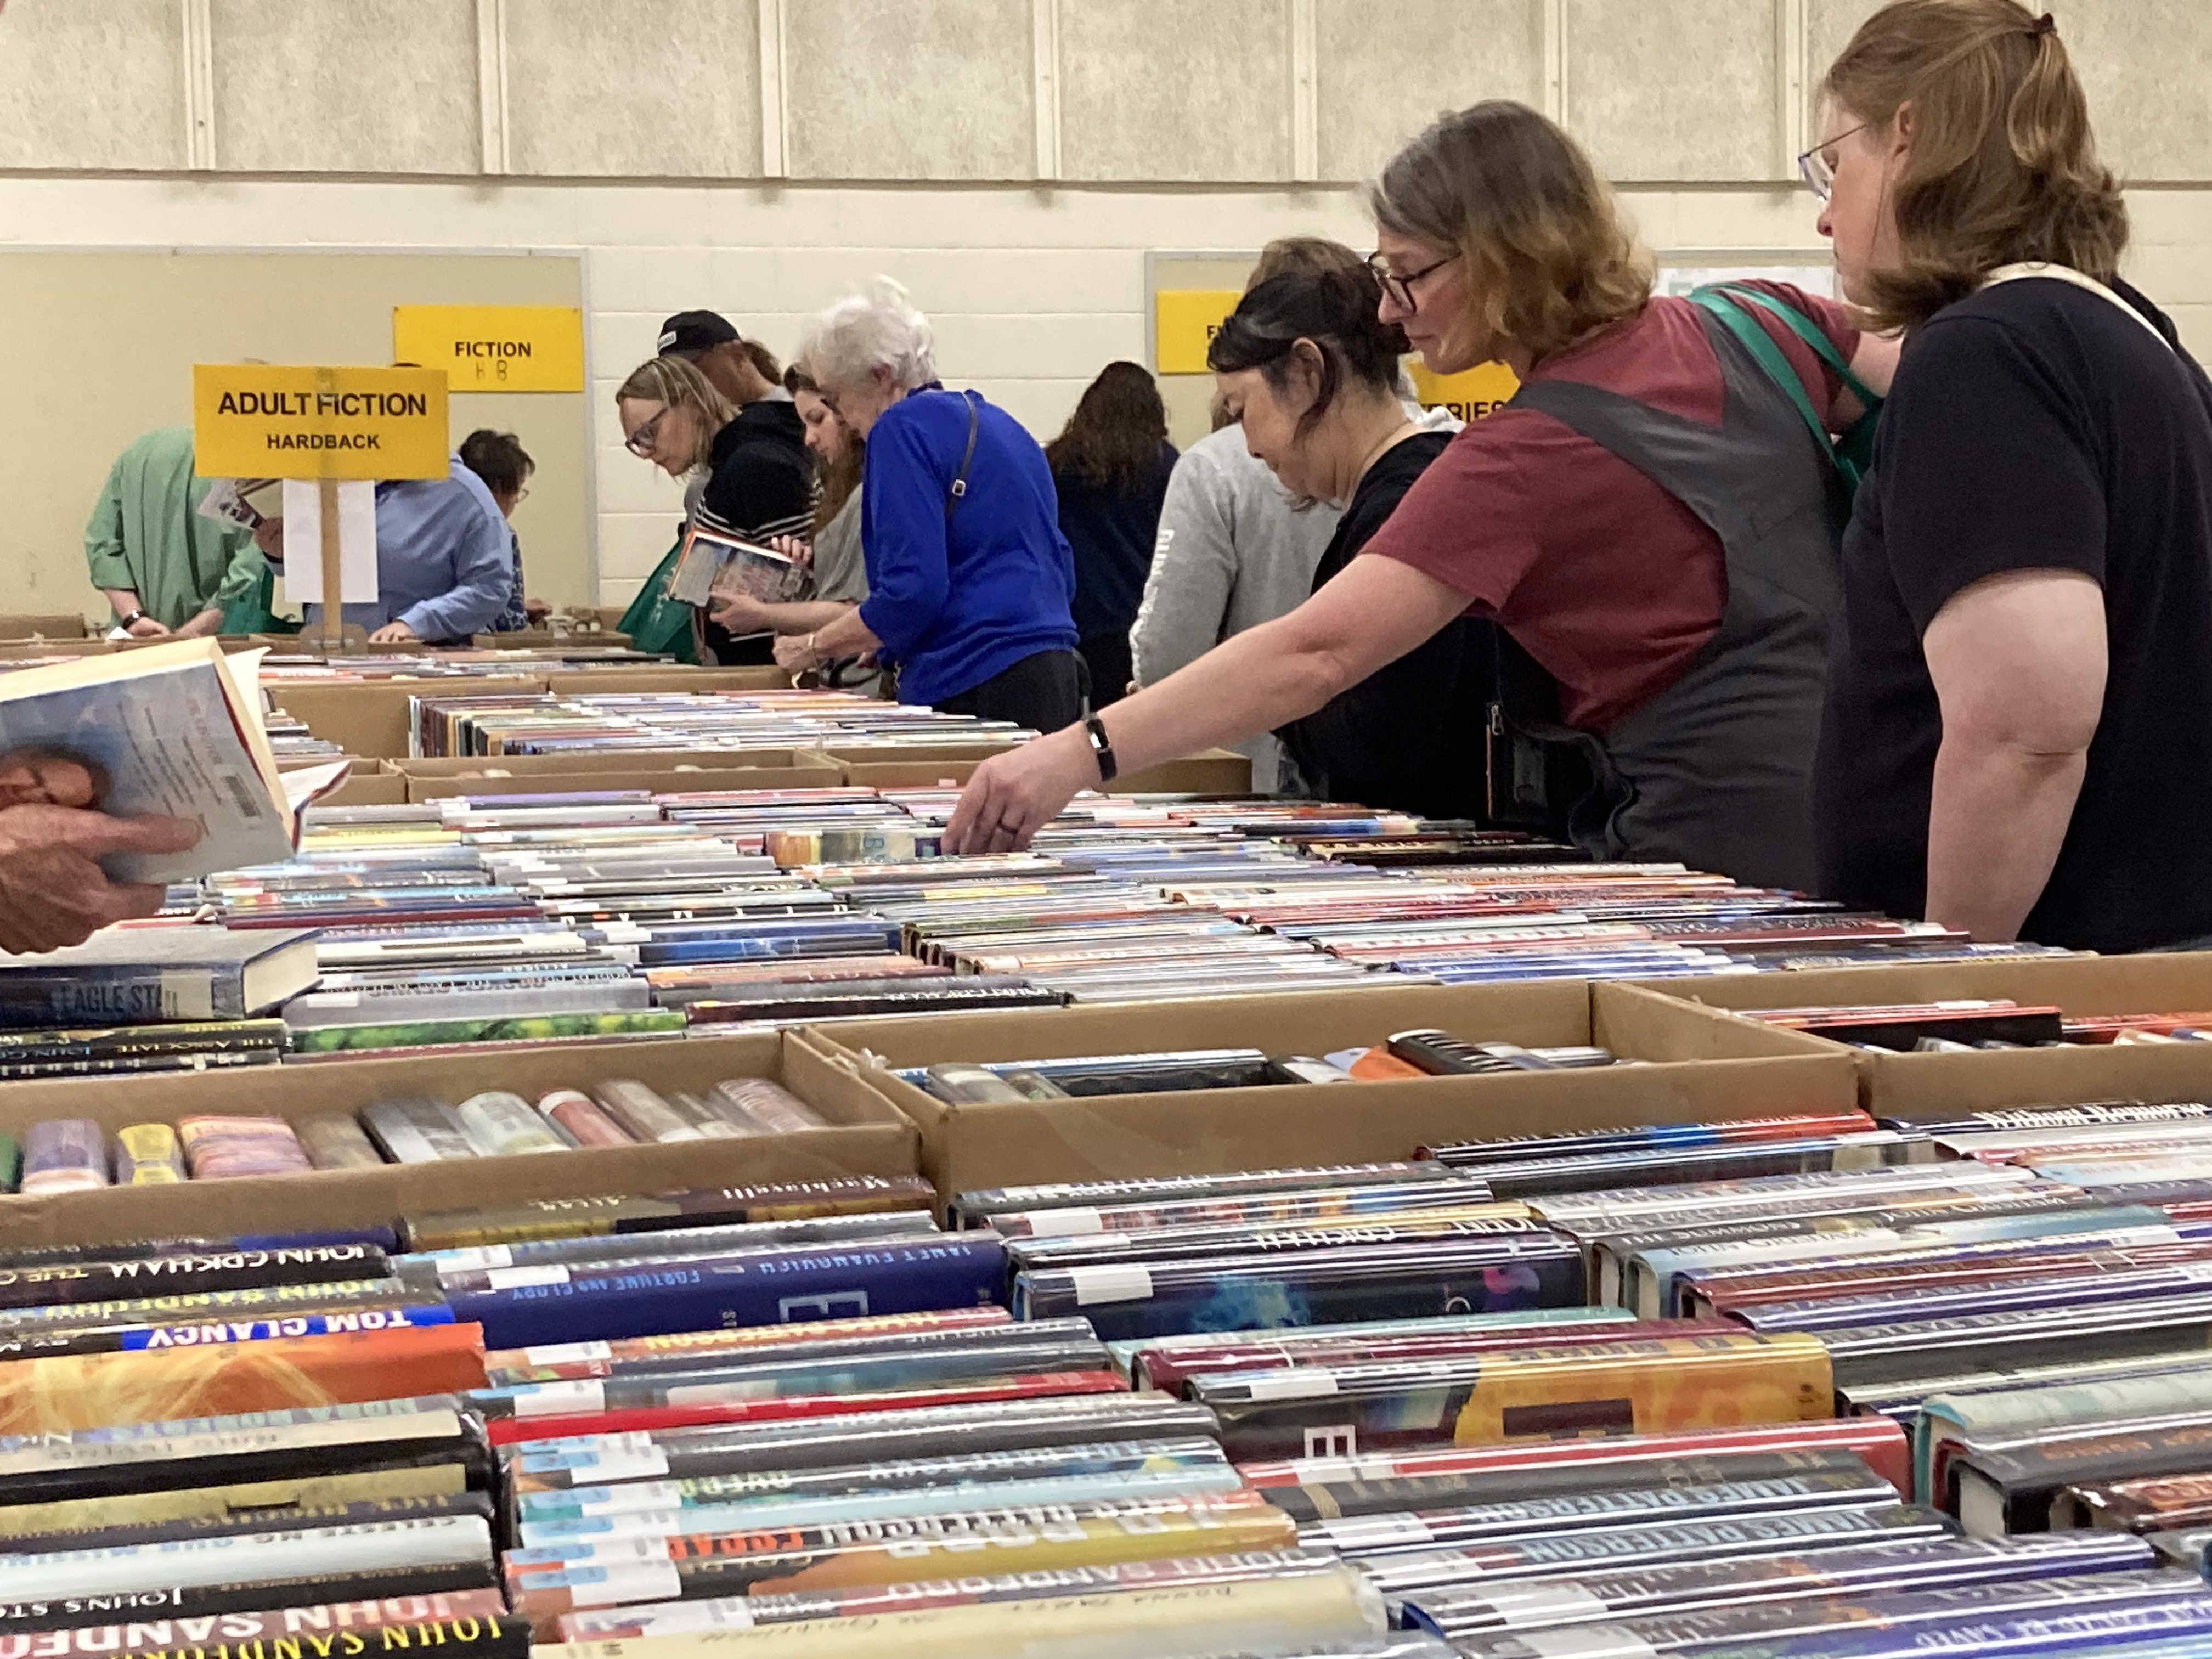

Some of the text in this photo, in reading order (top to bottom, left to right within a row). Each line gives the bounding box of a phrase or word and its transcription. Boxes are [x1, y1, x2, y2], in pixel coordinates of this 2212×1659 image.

[455, 341, 531, 358] FICTION
[476, 359, 508, 382] H B
[218, 392, 427, 416] ADULT FICTION
[267, 433, 380, 450] HARDBACK
[145, 1317, 308, 1348] CLANCY
[324, 1311, 411, 1333] TOM
[1520, 1523, 1747, 1562] PATTERSON
[283, 1594, 453, 1633] JOHN
[380, 1616, 501, 1650] JOHN
